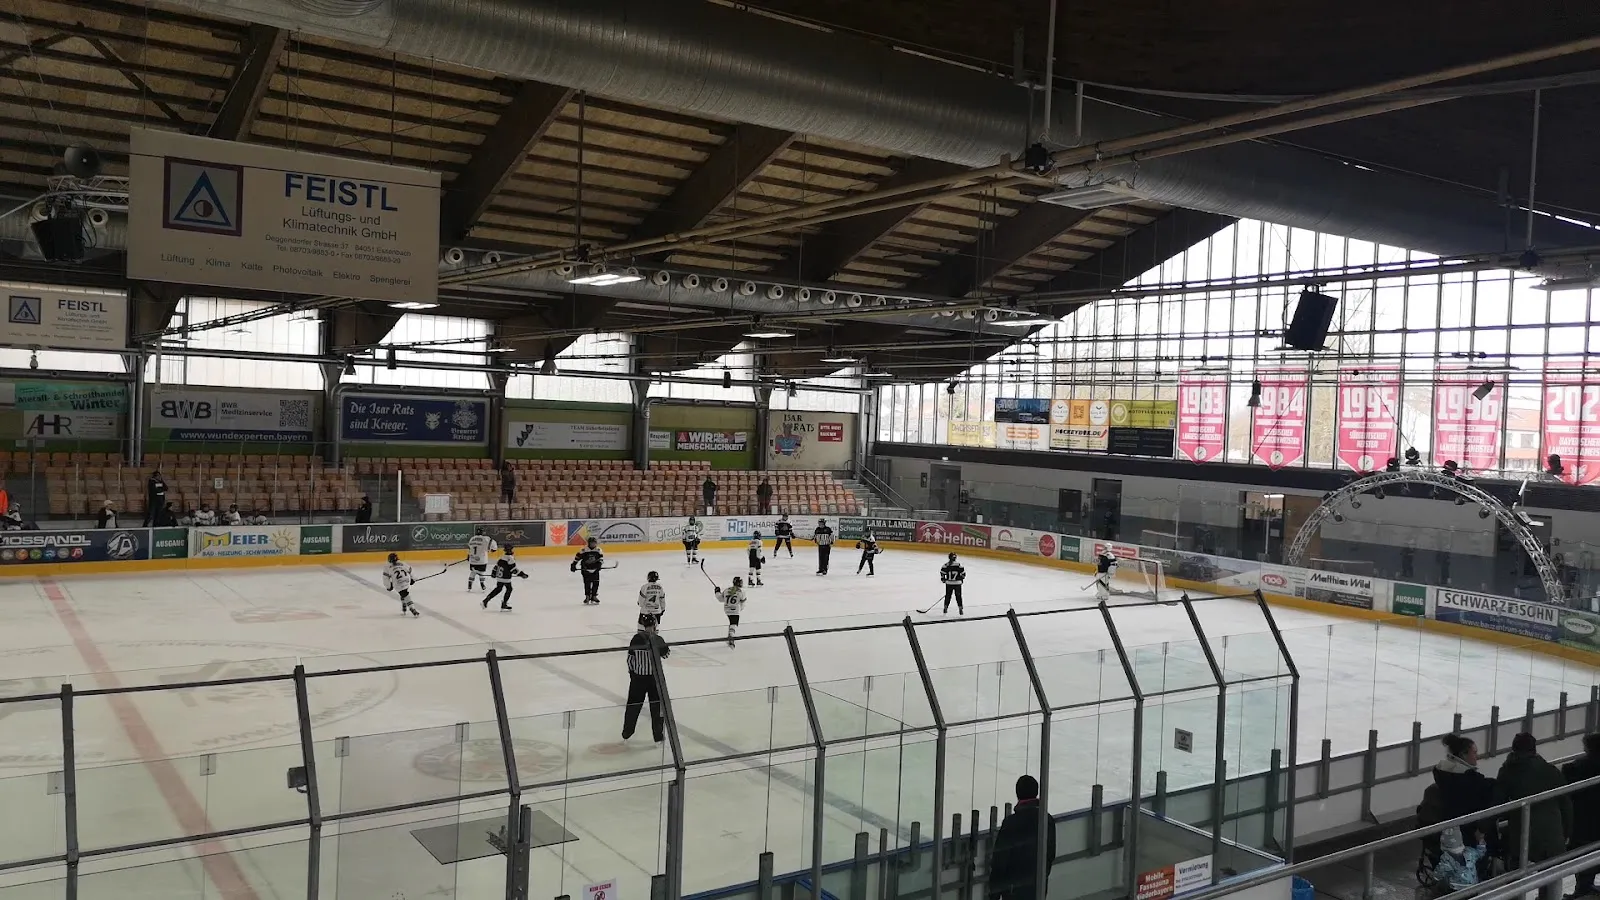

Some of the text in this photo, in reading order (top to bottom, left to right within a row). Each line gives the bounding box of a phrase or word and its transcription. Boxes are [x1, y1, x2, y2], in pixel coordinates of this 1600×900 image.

[285, 173, 398, 212] FEISTL
[302, 206, 381, 226] Lüftungs- und
[283, 218, 397, 241] Klimatechnik GmbH
[265, 234, 312, 247] Deggendorfer
[161, 253, 195, 267] Lüftung
[205, 258, 231, 268] Klima
[273, 264, 323, 277] Photovoltaik
[333, 270, 360, 281] Elektro
[370, 274, 411, 286] Spenglerei
[58, 299, 108, 313] FEISTL
[70, 399, 120, 410] Winter
[1182, 386, 1223, 415] 1983
[1342, 386, 1395, 418] 1995
[1438, 386, 1501, 420] 1996
[160, 399, 211, 423] BWB
[350, 401, 366, 414] Die
[392, 403, 415, 415] Rats
[26, 414, 73, 434] AHR
[350, 418, 408, 431] sind Krieger.
[784, 414, 803, 422] ISAR
[793, 423, 815, 432] RATS
[180, 431, 308, 442] www.wundexperten.bayern
[689, 432, 713, 443] WIR
[677, 443, 744, 451] MENSCHLICHKEIT
[840, 524, 863, 532] Schmid
[866, 519, 916, 530] LAMA LANDAU
[203, 531, 268, 549] MEIER
[430, 532, 470, 541] Vogginger
[156, 540, 185, 548] AUSGANG
[947, 571, 959, 580] 17
[1310, 573, 1371, 589] Matthias Wild
[725, 595, 737, 604] 16
[1396, 595, 1423, 605] AUSGANG
[1444, 592, 1554, 622] SCHWARZ SOHN
[1179, 860, 1208, 875] Vermietung
[1145, 871, 1164, 882] Mobile
